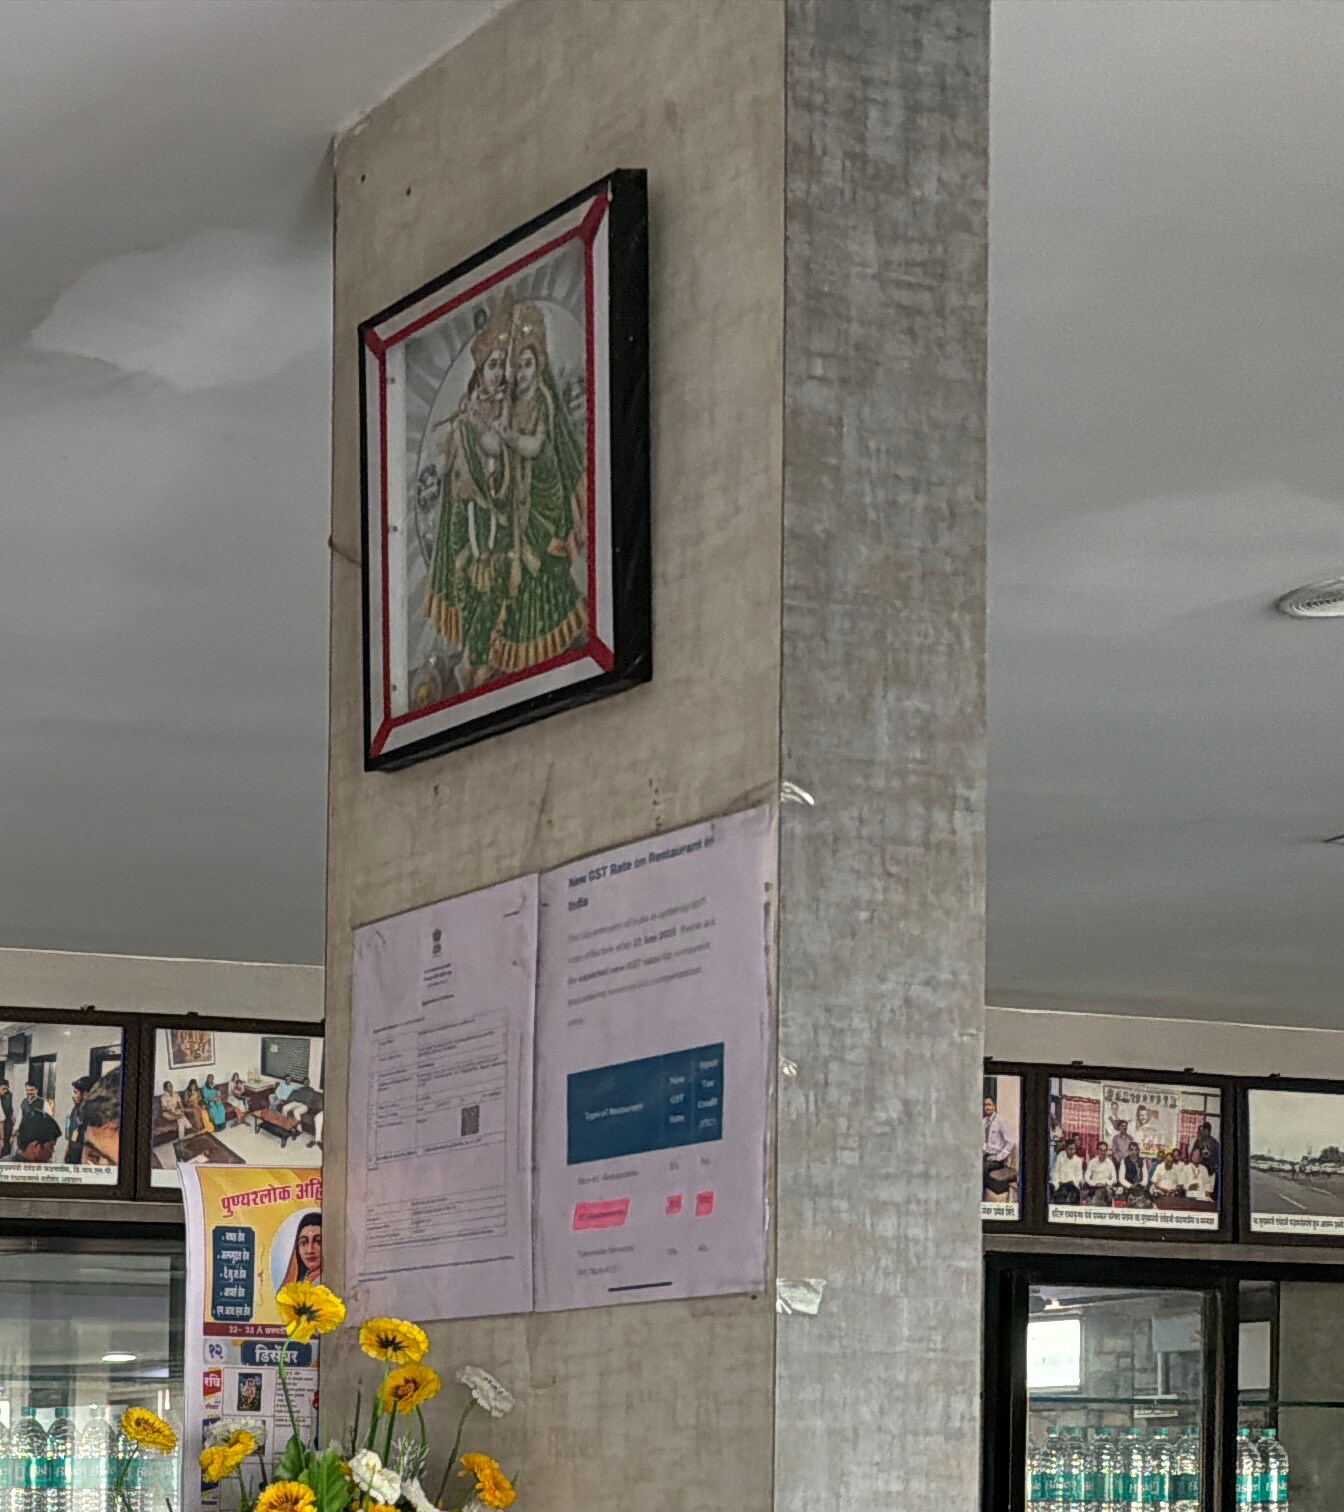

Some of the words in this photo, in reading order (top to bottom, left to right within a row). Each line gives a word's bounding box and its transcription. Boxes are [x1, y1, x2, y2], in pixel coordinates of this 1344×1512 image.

[588, 866, 608, 882] GST
[609, 860, 633, 877] Rate
[648, 840, 702, 865] Restaurant
